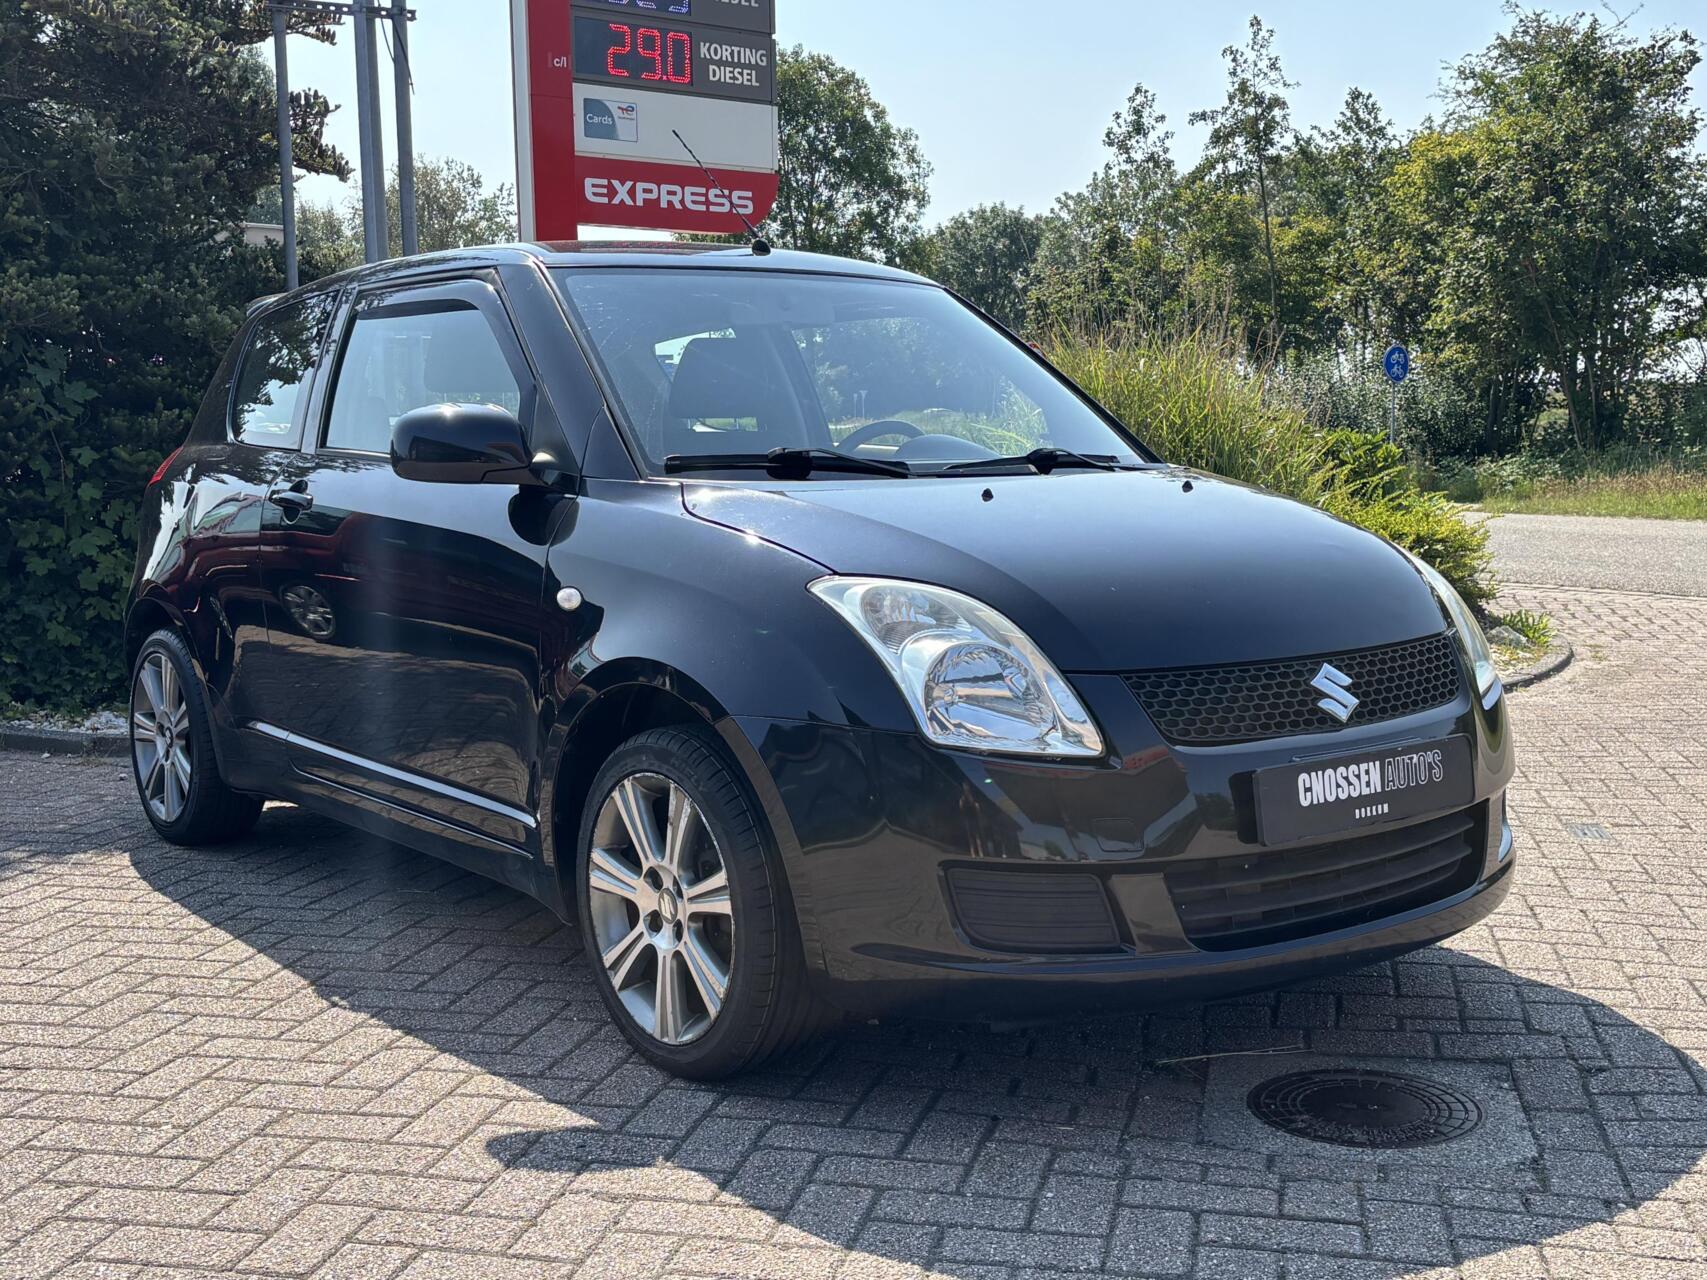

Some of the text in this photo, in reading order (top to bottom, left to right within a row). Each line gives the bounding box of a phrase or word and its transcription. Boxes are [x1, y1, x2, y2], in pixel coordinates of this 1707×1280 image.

[700, 42, 767, 66] KORTING
[708, 65, 760, 87] DIESEL
[586, 113, 613, 125] Cards
[584, 177, 753, 214] EXPRESS
[1297, 749, 1444, 807] CNOSSEN AUTO'S
